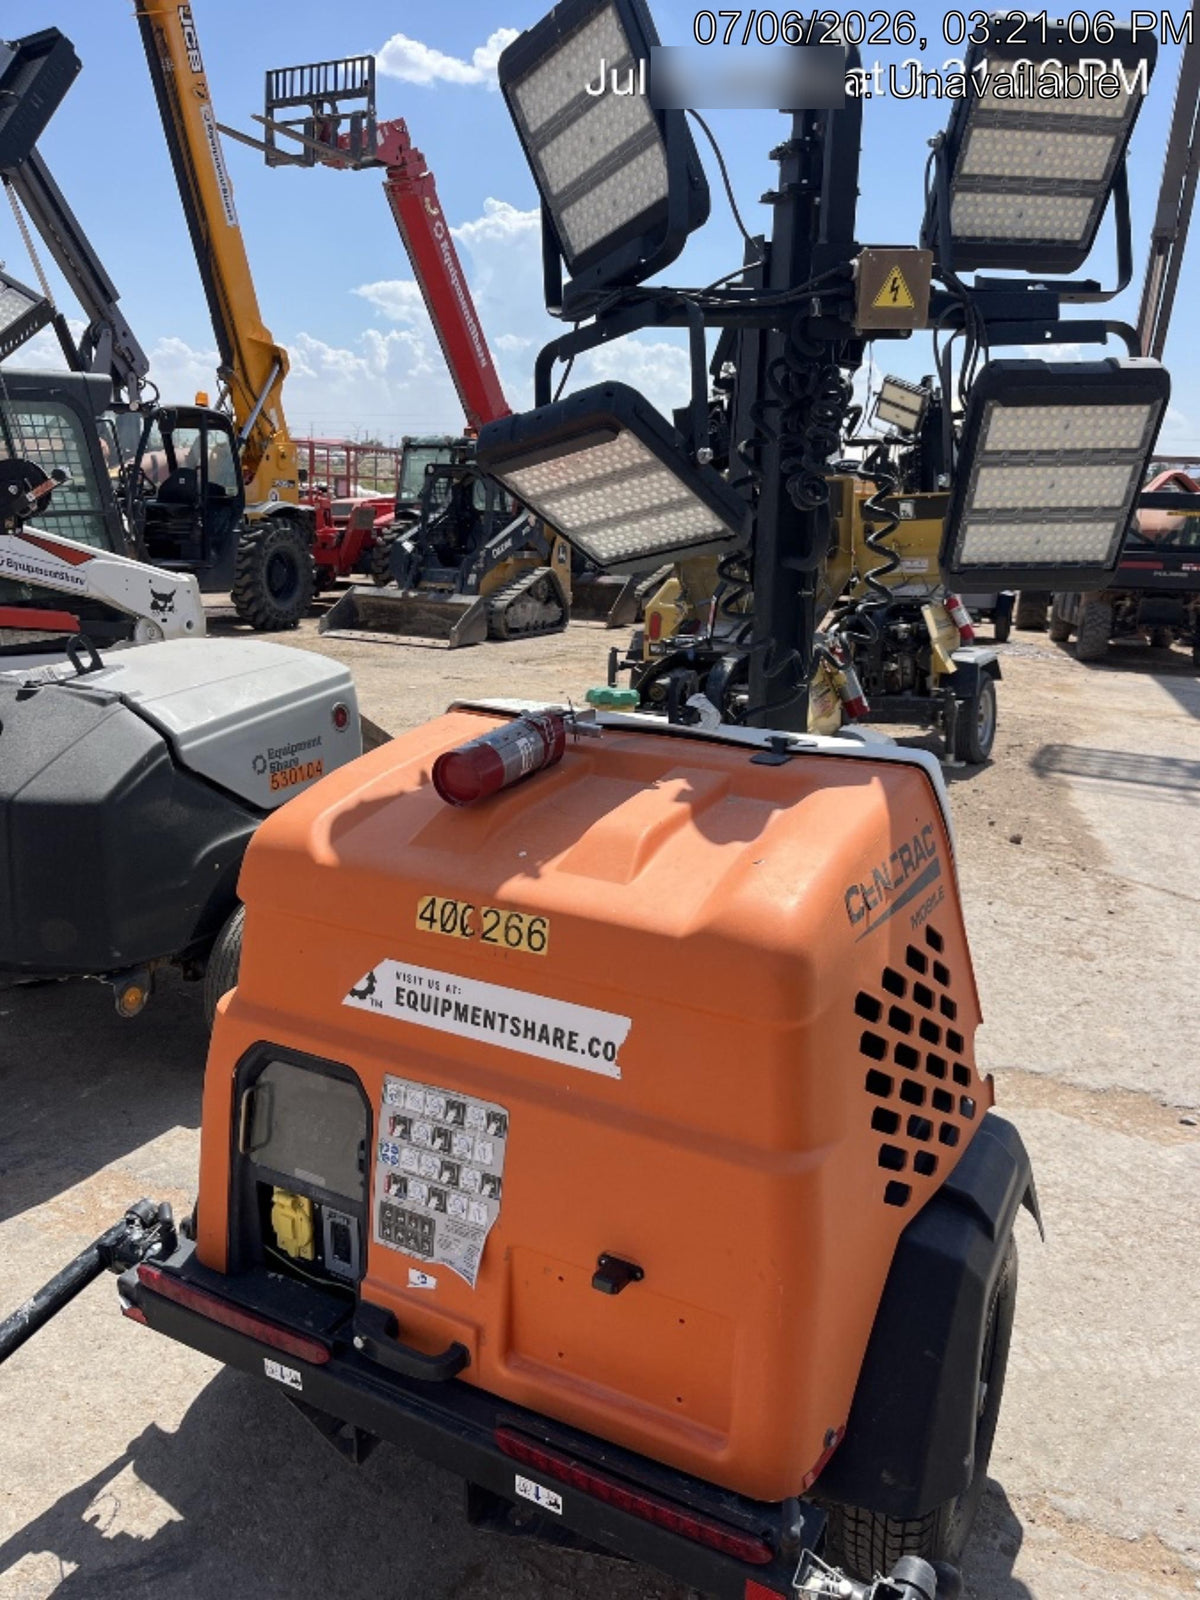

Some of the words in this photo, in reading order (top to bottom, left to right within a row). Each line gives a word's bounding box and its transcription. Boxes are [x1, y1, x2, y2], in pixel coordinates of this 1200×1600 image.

[177, 5, 204, 73] JCB
[267, 735, 322, 760] Equipment
[269, 757, 300, 774] Share
[396, 971, 423, 986] VISIT
[427, 979, 440, 991] US
[395, 986, 616, 1062] EQUIPMENTSHARE.CO
